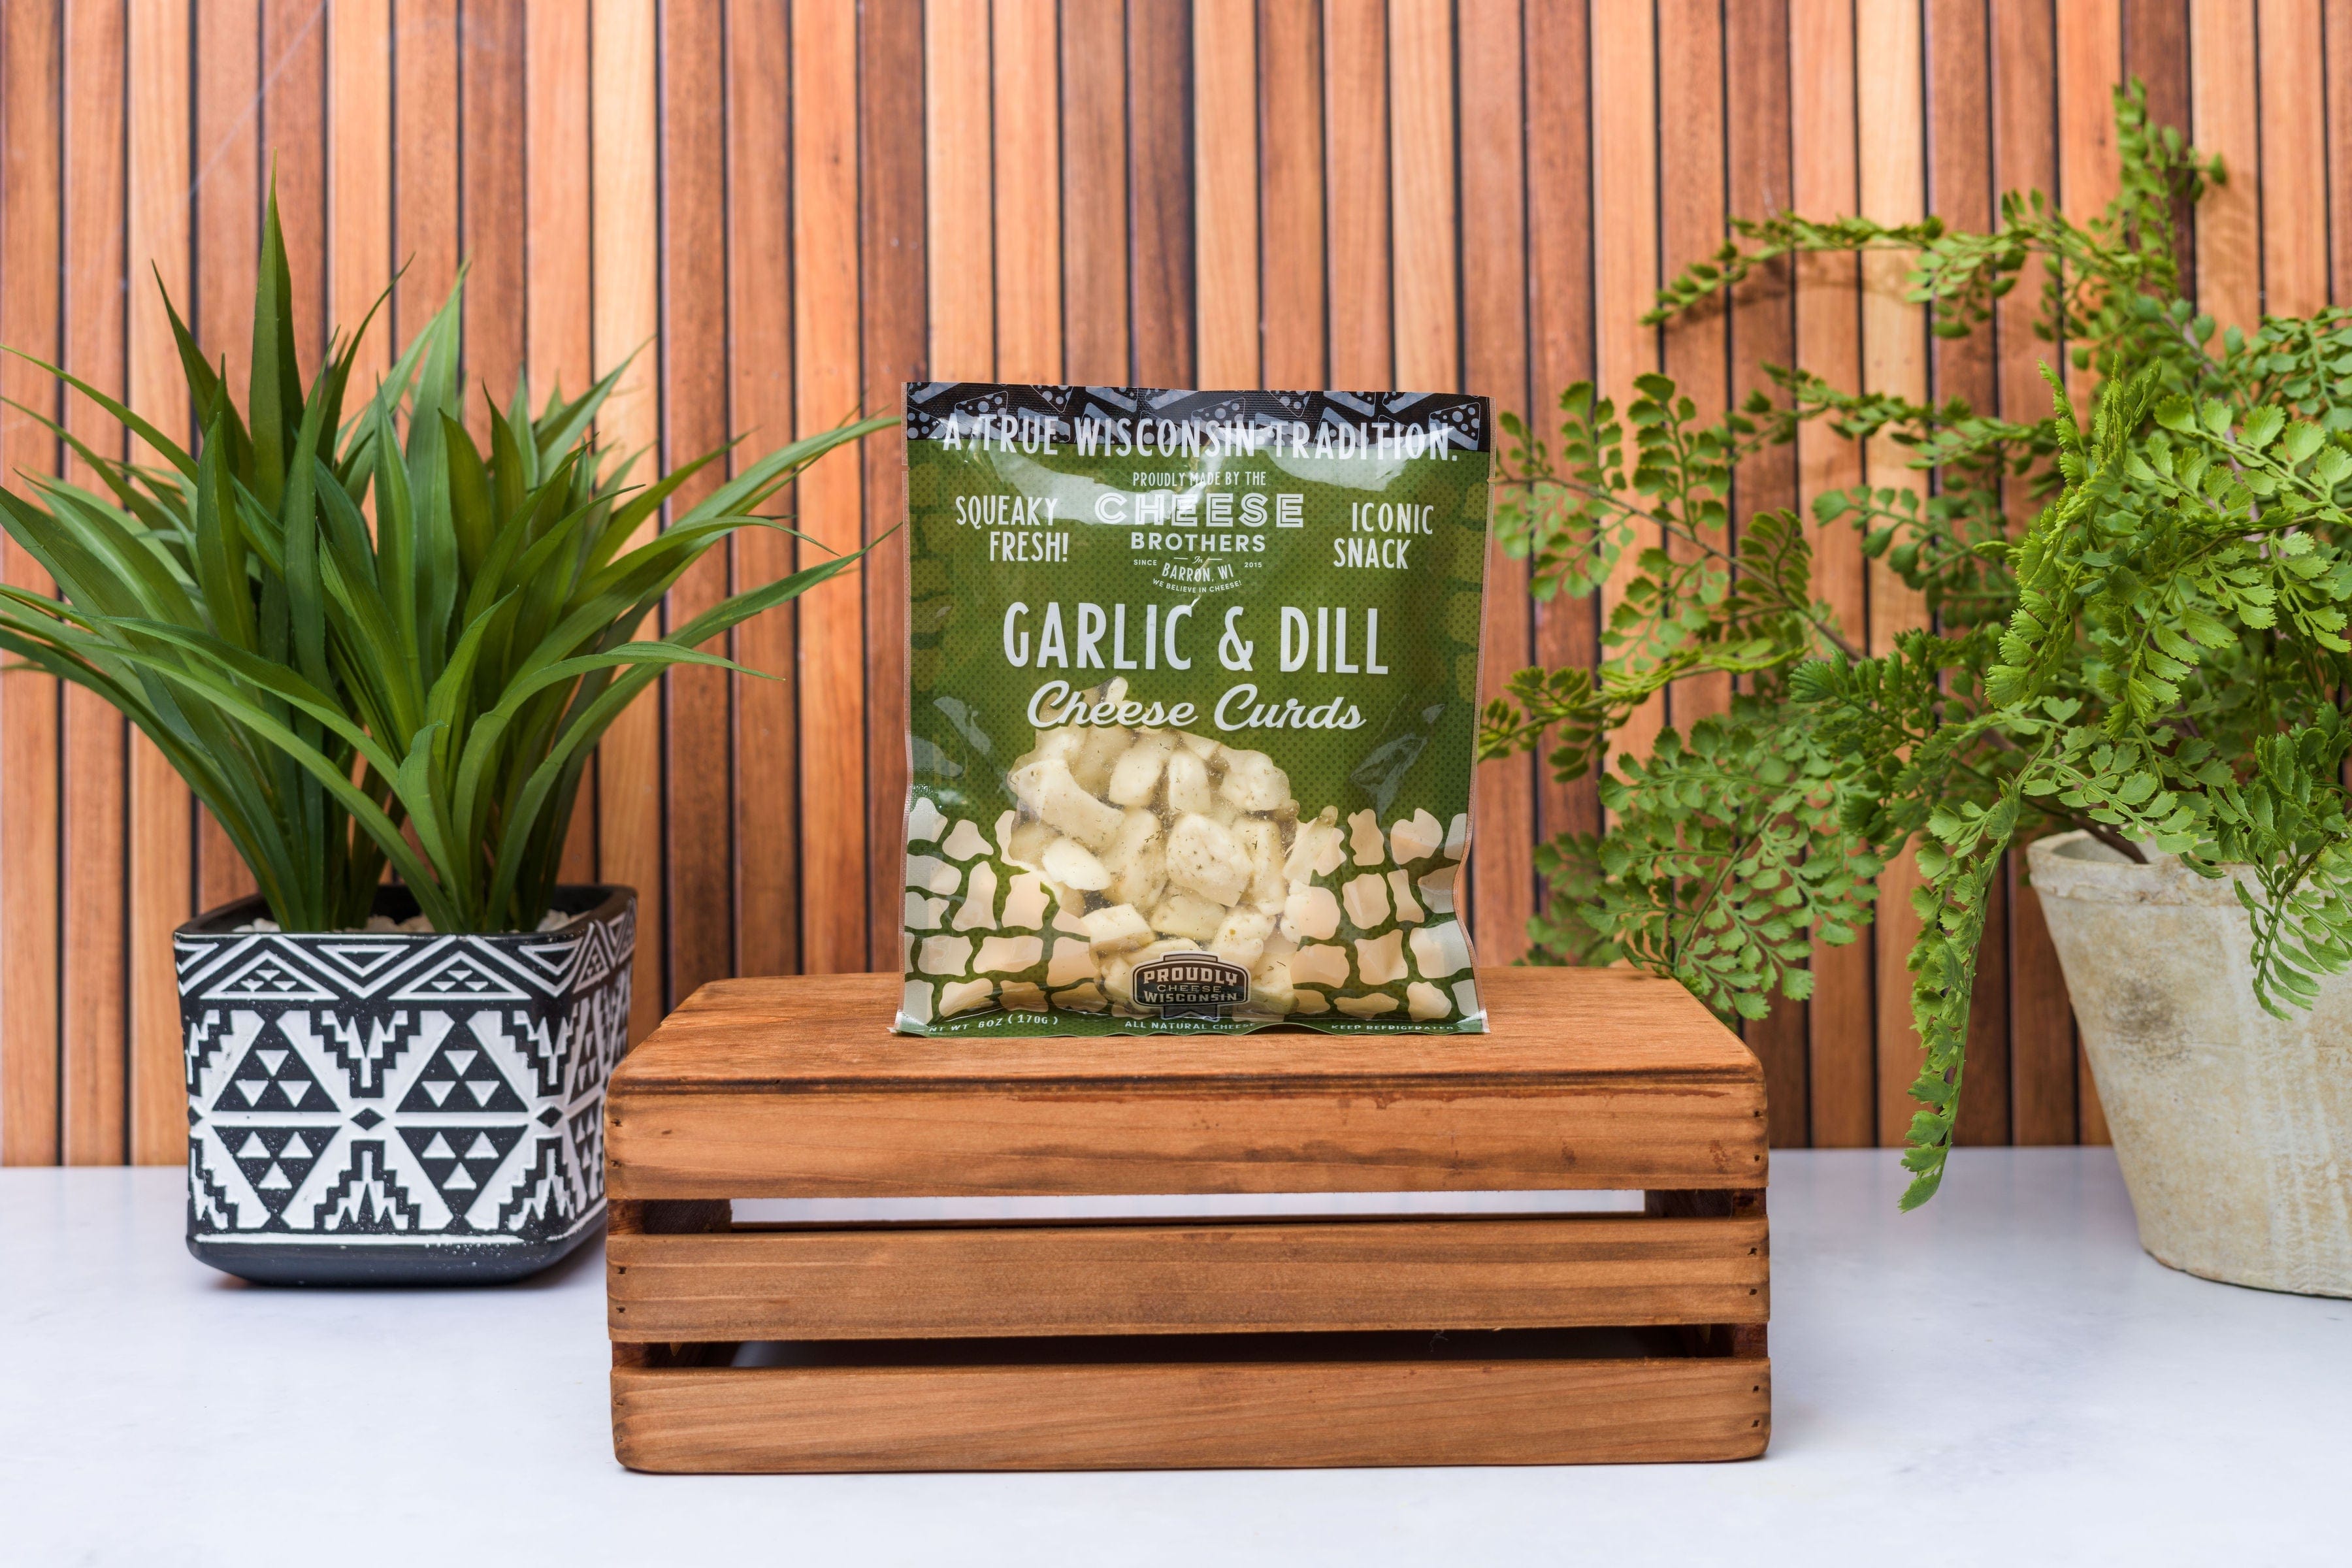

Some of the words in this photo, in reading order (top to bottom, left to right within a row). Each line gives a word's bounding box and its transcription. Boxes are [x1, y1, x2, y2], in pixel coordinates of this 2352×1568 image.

[943, 413, 962, 451] A
[980, 414, 1058, 455] TRUE
[1074, 417, 1255, 458] WISCONSIN
[1270, 421, 1458, 461] TRADITION.
[1133, 472, 1185, 487] PROUDLY
[1190, 472, 1220, 486] MADE
[1225, 472, 1239, 485] BY
[1245, 471, 1266, 485] THE
[956, 495, 1058, 530] SQUEAKY
[1094, 492, 1304, 528] CHEESE
[1352, 502, 1434, 534] ICONIC
[990, 531, 1069, 562] FRESH!
[1131, 532, 1266, 552] BROTHERS
[1192, 555, 1203, 564] In
[1333, 538, 1411, 570] SNACK
[1162, 562, 1214, 582] BARRON,
[1217, 564, 1234, 580] WI
[1152, 578, 1163, 587] WE
[1166, 583, 1196, 593] BELIEVE
[1209, 580, 1242, 592] CHEESE!
[1003, 600, 1192, 670] GARLIC
[1218, 605, 1253, 672] &
[1280, 606, 1388, 675] DILL
[1026, 679, 1198, 729] Cheese
[1213, 683, 1367, 731] Curds
[1143, 967, 1238, 987] PROUDLY
[1144, 990, 1237, 1003] WISCONSIN
[1156, 984, 1222, 992] CHEESE
[978, 1018, 1002, 1028] 6OZ
[1151, 1021, 1207, 1030] NATURAL
